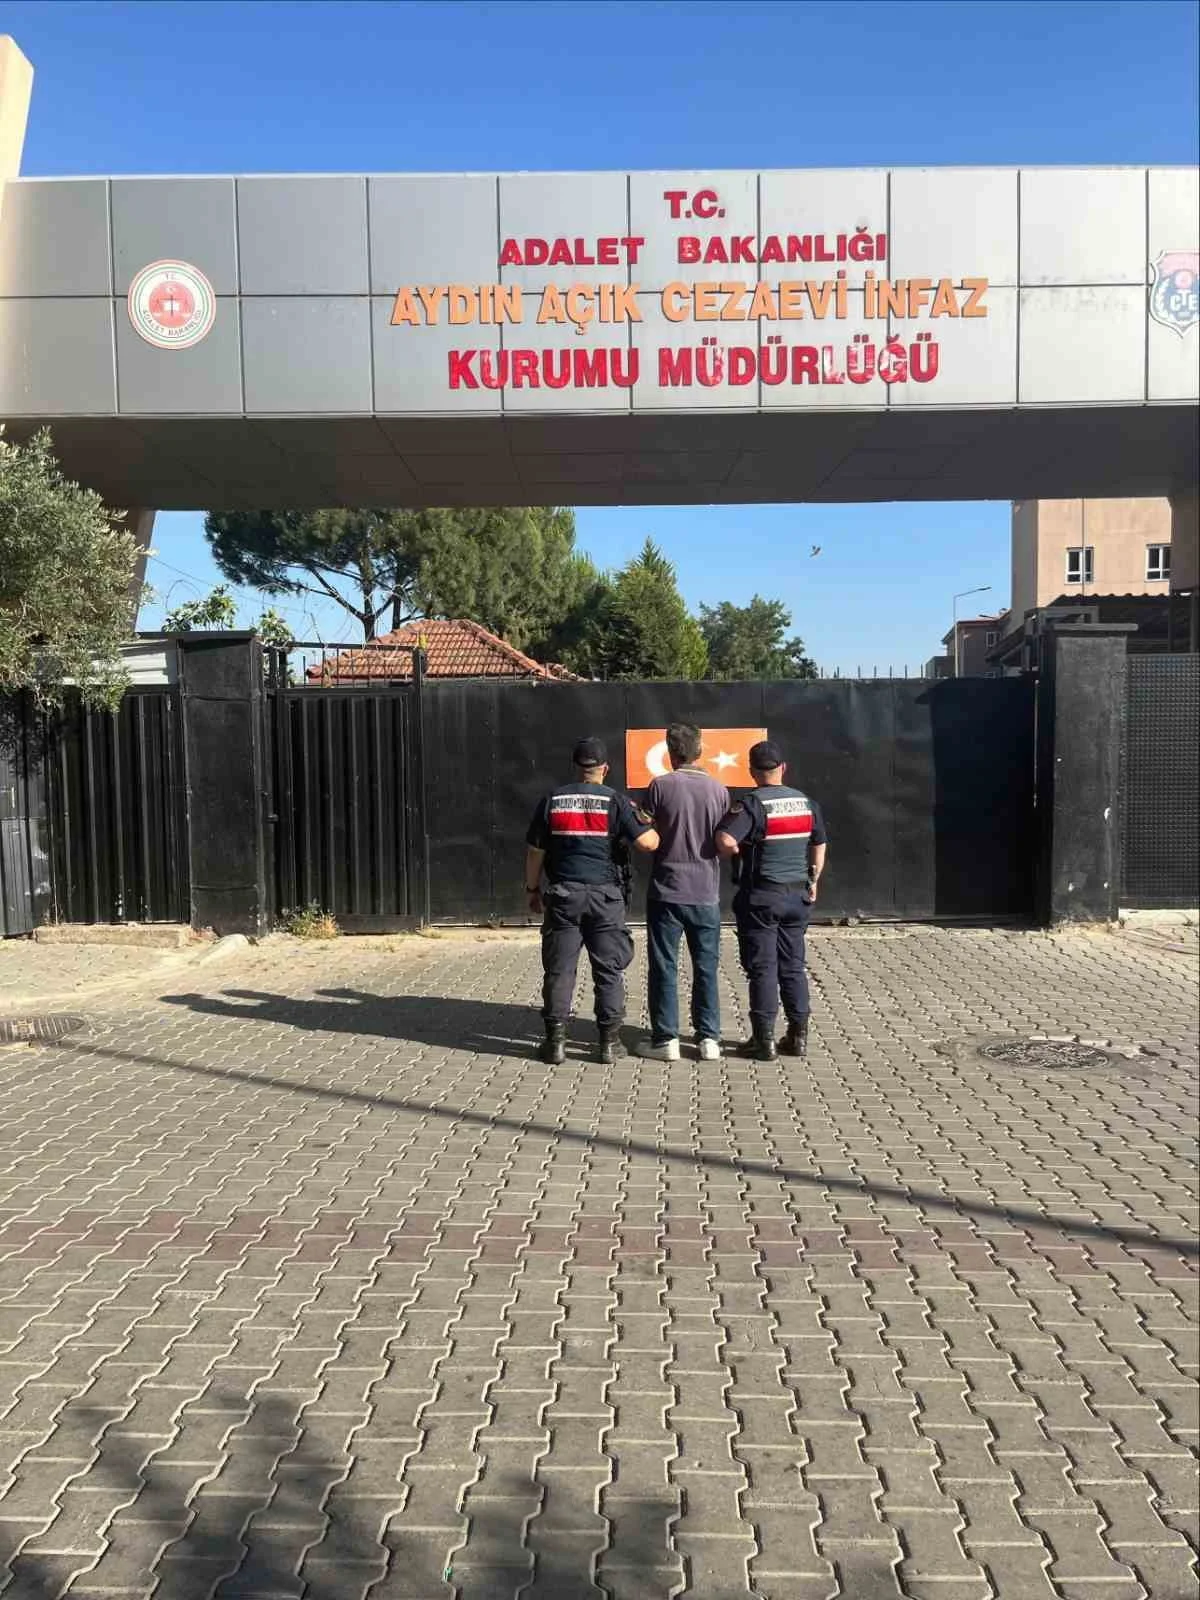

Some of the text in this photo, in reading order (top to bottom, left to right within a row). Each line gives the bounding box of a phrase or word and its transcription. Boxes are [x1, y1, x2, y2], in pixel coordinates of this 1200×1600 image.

[664, 190, 725, 218] T.C.
[499, 222, 886, 265] ADALET BAKANLIĞI
[391, 270, 988, 334] AYDIN AÇIK CEZAEVİ İNFAZ
[448, 333, 938, 389] KURUMU MÜDÜRLÜĞÜ
